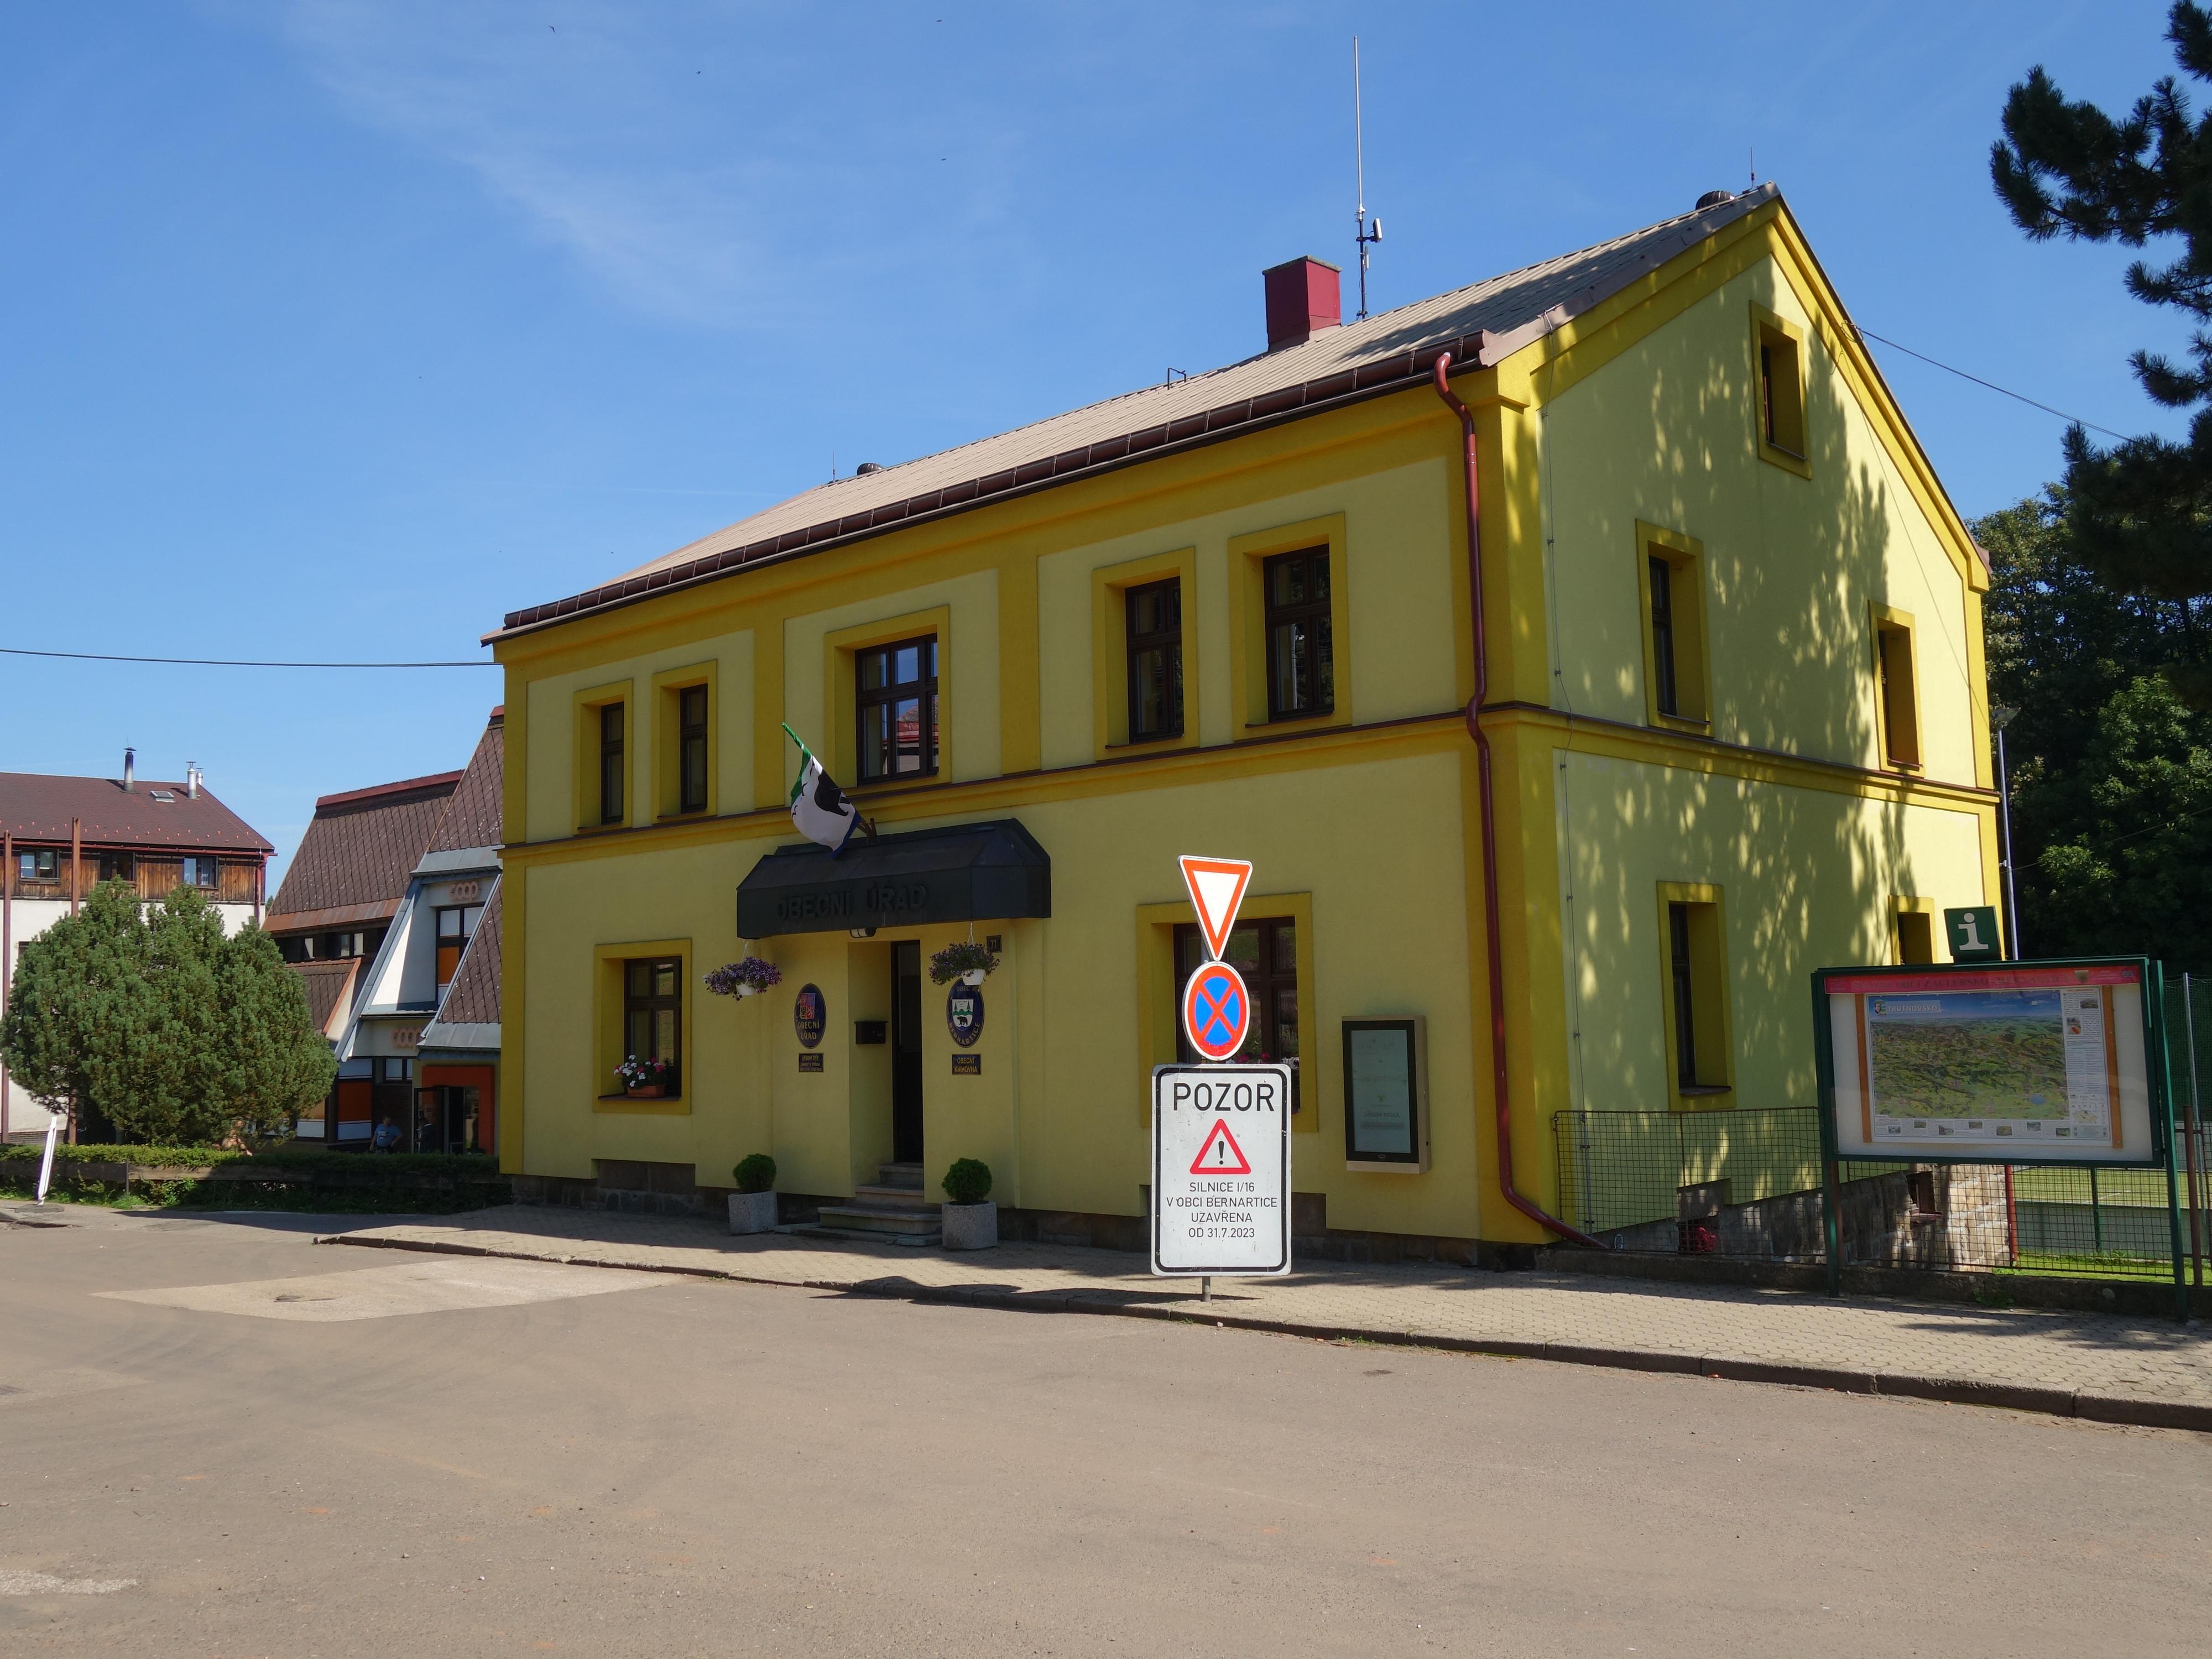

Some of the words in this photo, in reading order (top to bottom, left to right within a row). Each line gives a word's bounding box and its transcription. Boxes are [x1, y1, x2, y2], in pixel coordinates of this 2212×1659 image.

[990, 939, 997, 950] 77
[797, 1020, 820, 1029] OBECNÍ
[949, 1022, 980, 1045] BERNARTICE
[1173, 1082, 1275, 1112] POZOR
[1189, 1182, 1234, 1192] SILNICE
[1237, 1182, 1255, 1192] I/16
[1166, 1197, 1173, 1207] V
[1177, 1197, 1203, 1207] OBCI
[1206, 1197, 1278, 1207] BERNARTICE
[1191, 1209, 1253, 1223] UZAVŘENA
[1188, 1228, 1204, 1238] OD
[1207, 1228, 1255, 1238] 31.7.2023
